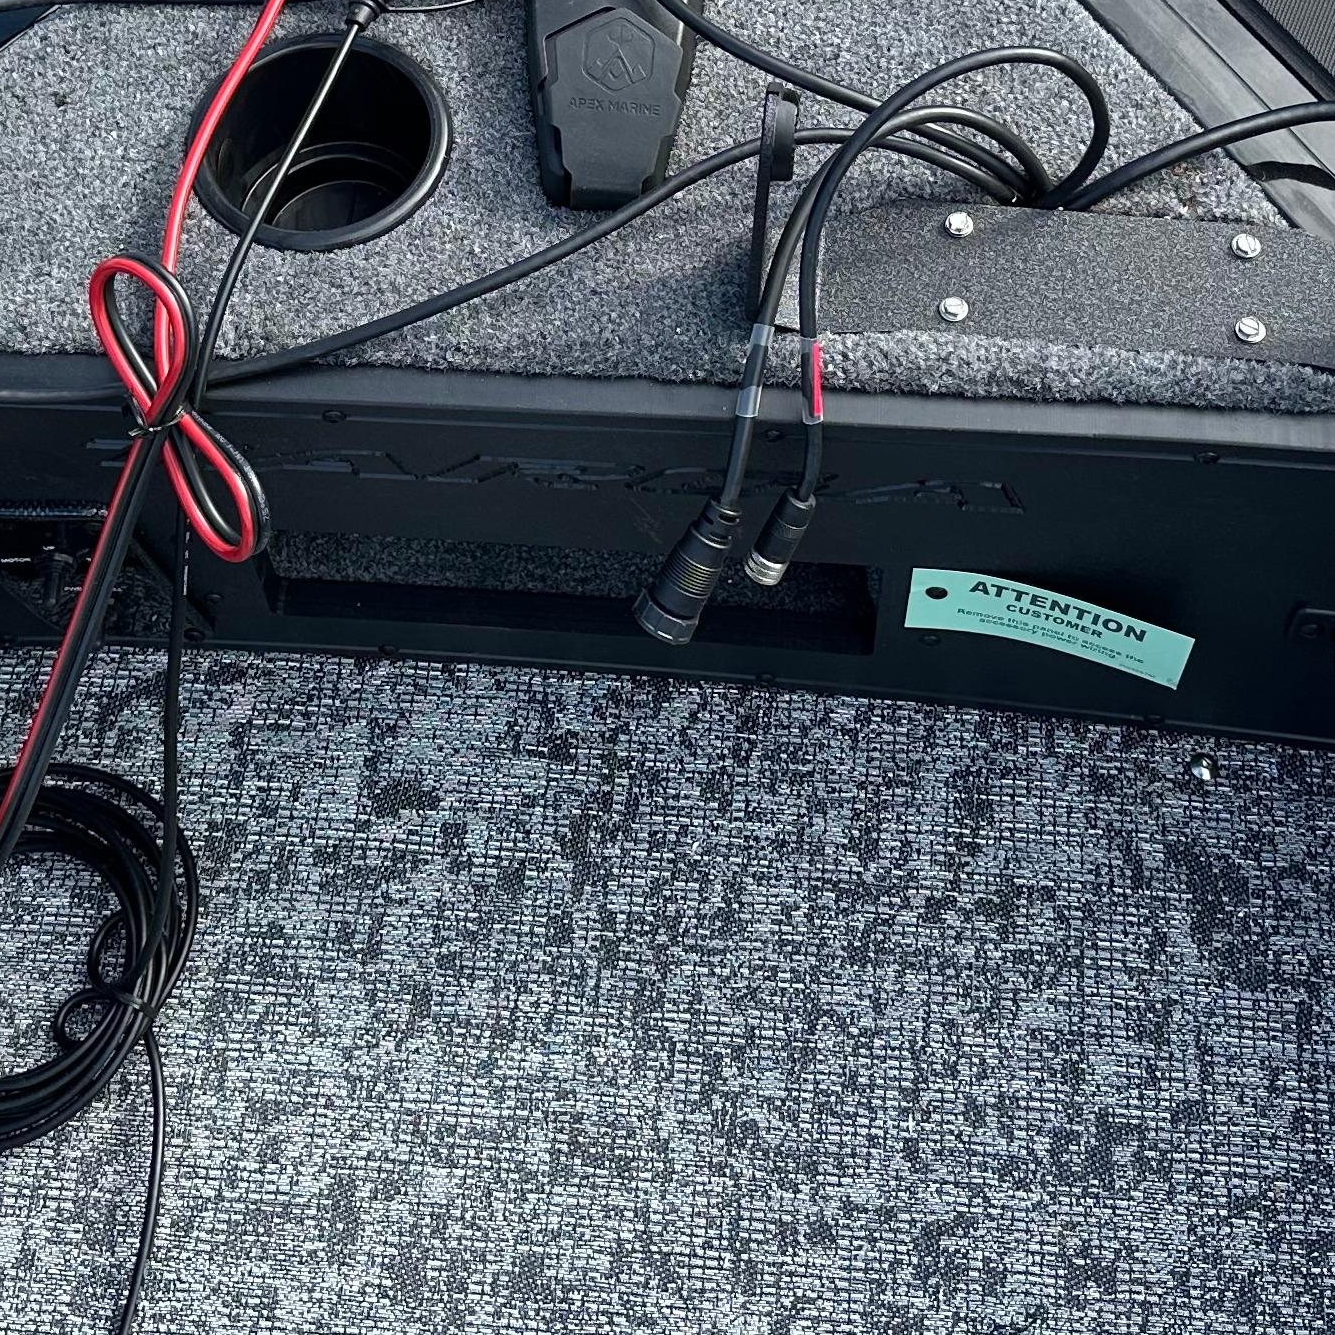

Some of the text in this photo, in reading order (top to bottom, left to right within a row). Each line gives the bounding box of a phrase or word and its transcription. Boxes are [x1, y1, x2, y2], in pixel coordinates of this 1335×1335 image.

[569, 97, 661, 117] APEX MARINE
[957, 608, 1005, 622] Remove
[968, 581, 1147, 643] ATTENTION
[1006, 604, 1103, 639] CUSTOMER
